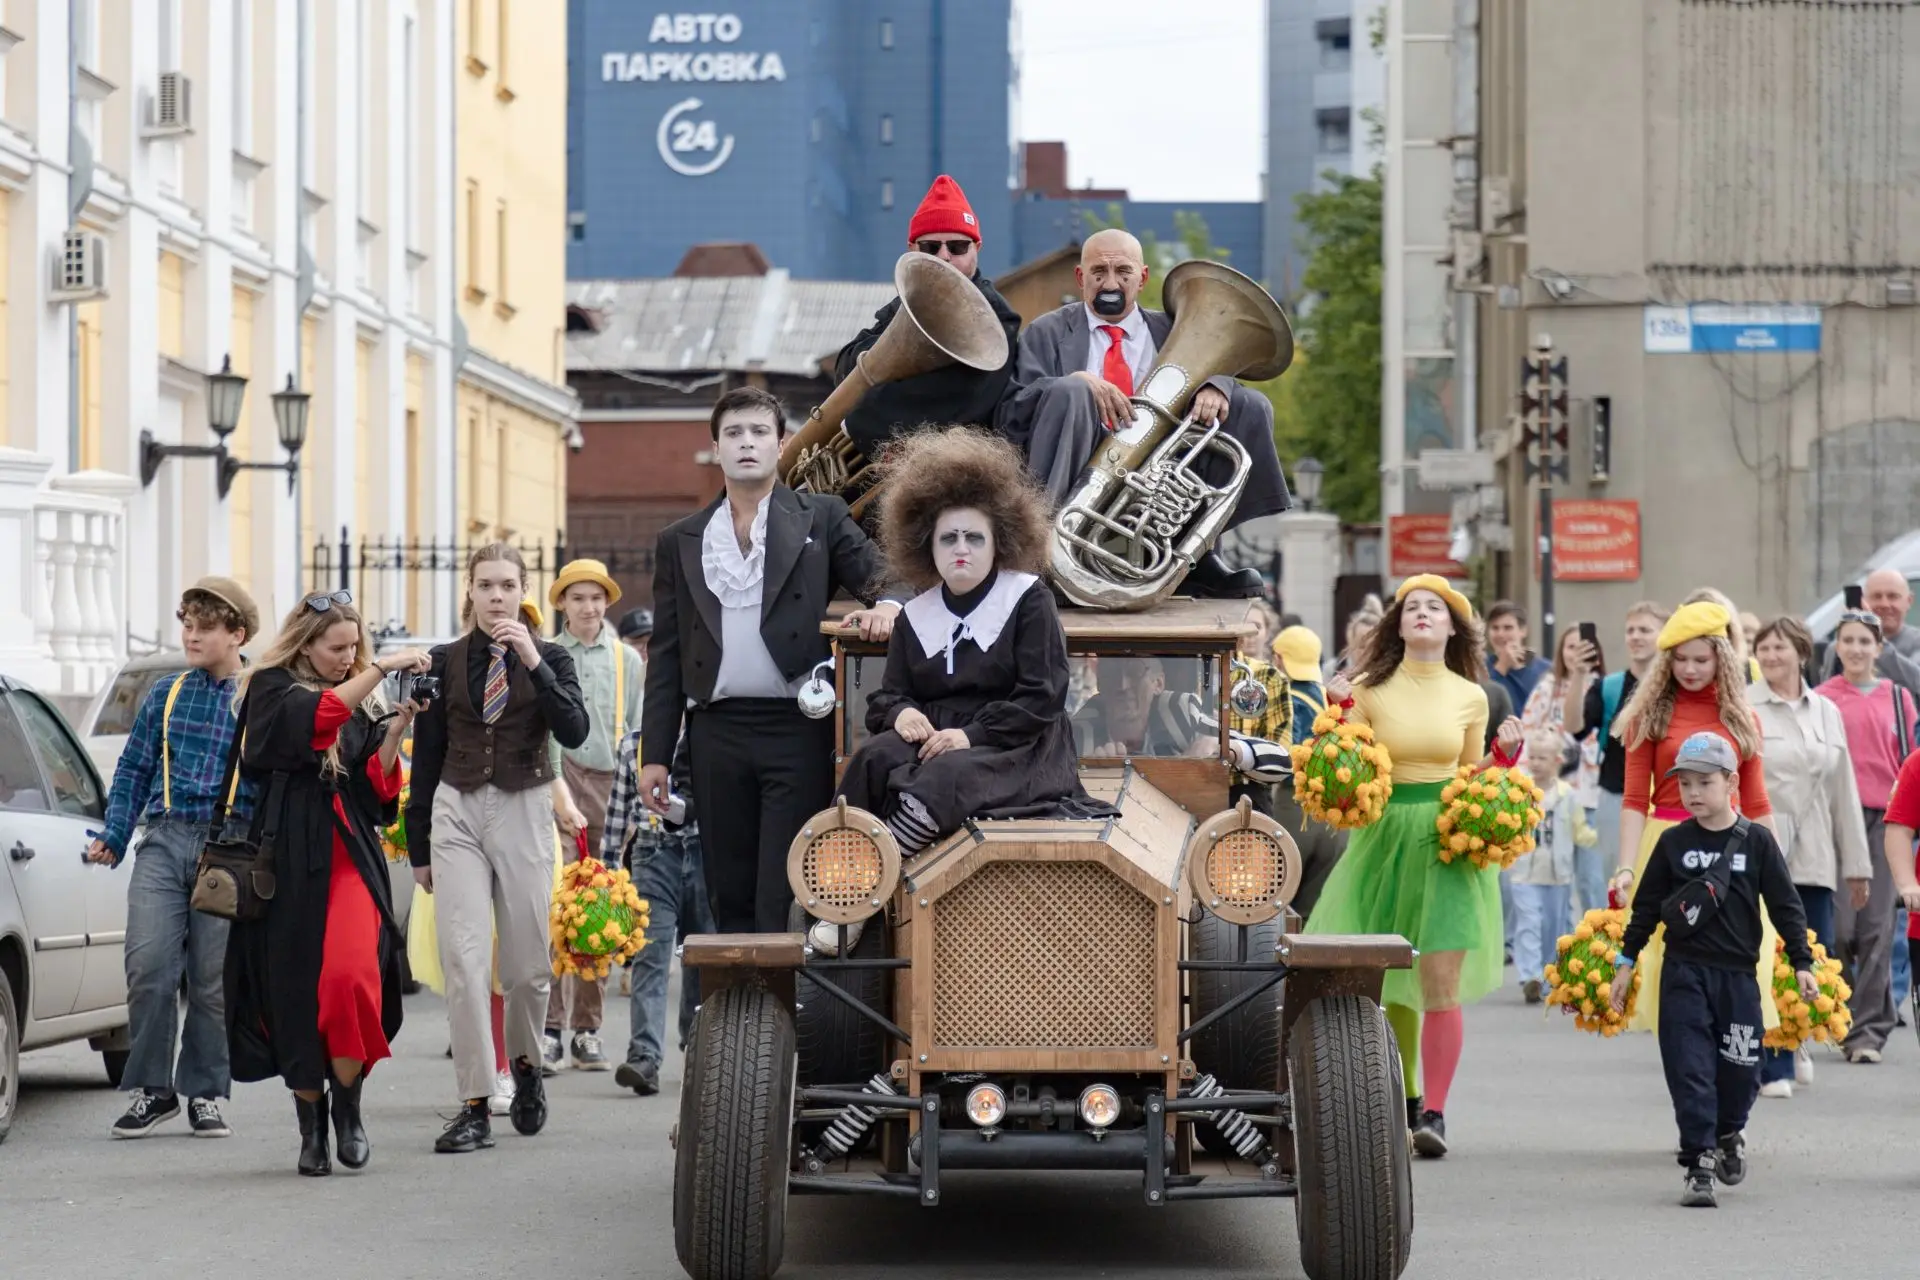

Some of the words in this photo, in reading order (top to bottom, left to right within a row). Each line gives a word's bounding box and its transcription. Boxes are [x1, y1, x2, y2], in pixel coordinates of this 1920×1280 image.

[649, 13, 742, 43] АВТО
[602, 52, 786, 82] ПАРКОВКА
[672, 120, 718, 151] 24
